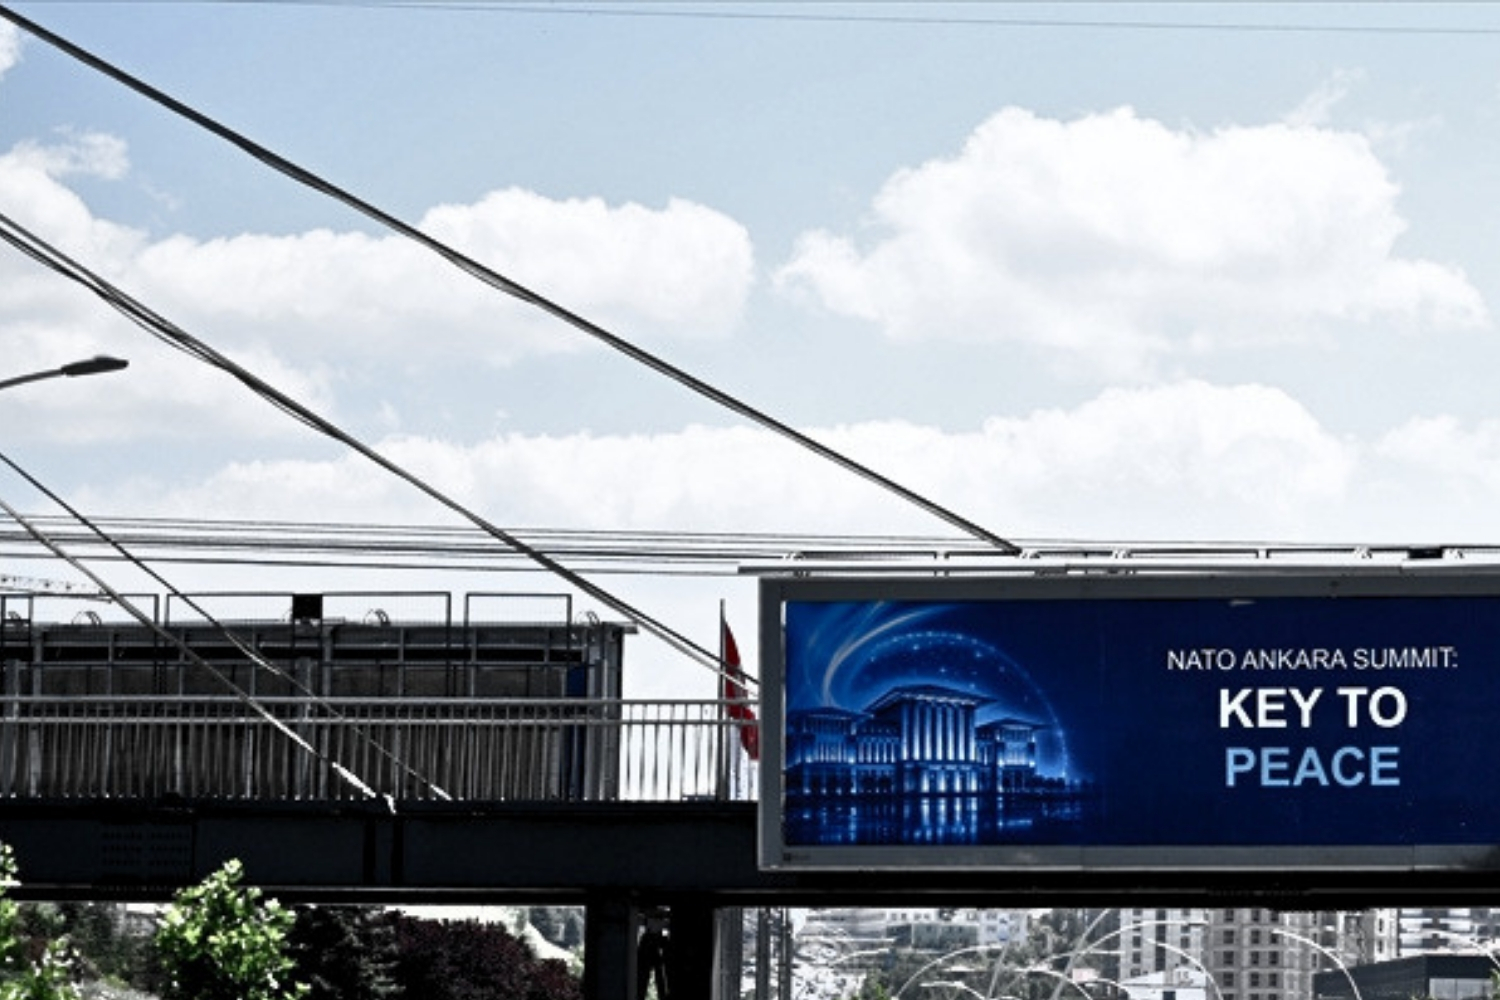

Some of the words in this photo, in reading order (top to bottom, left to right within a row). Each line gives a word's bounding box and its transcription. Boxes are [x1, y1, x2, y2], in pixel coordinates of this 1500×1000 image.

[1167, 649, 1236, 670] NATO
[1241, 648, 1347, 670] ANKARA
[1353, 646, 1458, 670] SUMMIT:
[1219, 688, 1323, 728] KEY
[1336, 686, 1407, 728] TO
[1225, 746, 1400, 787] PEACE
